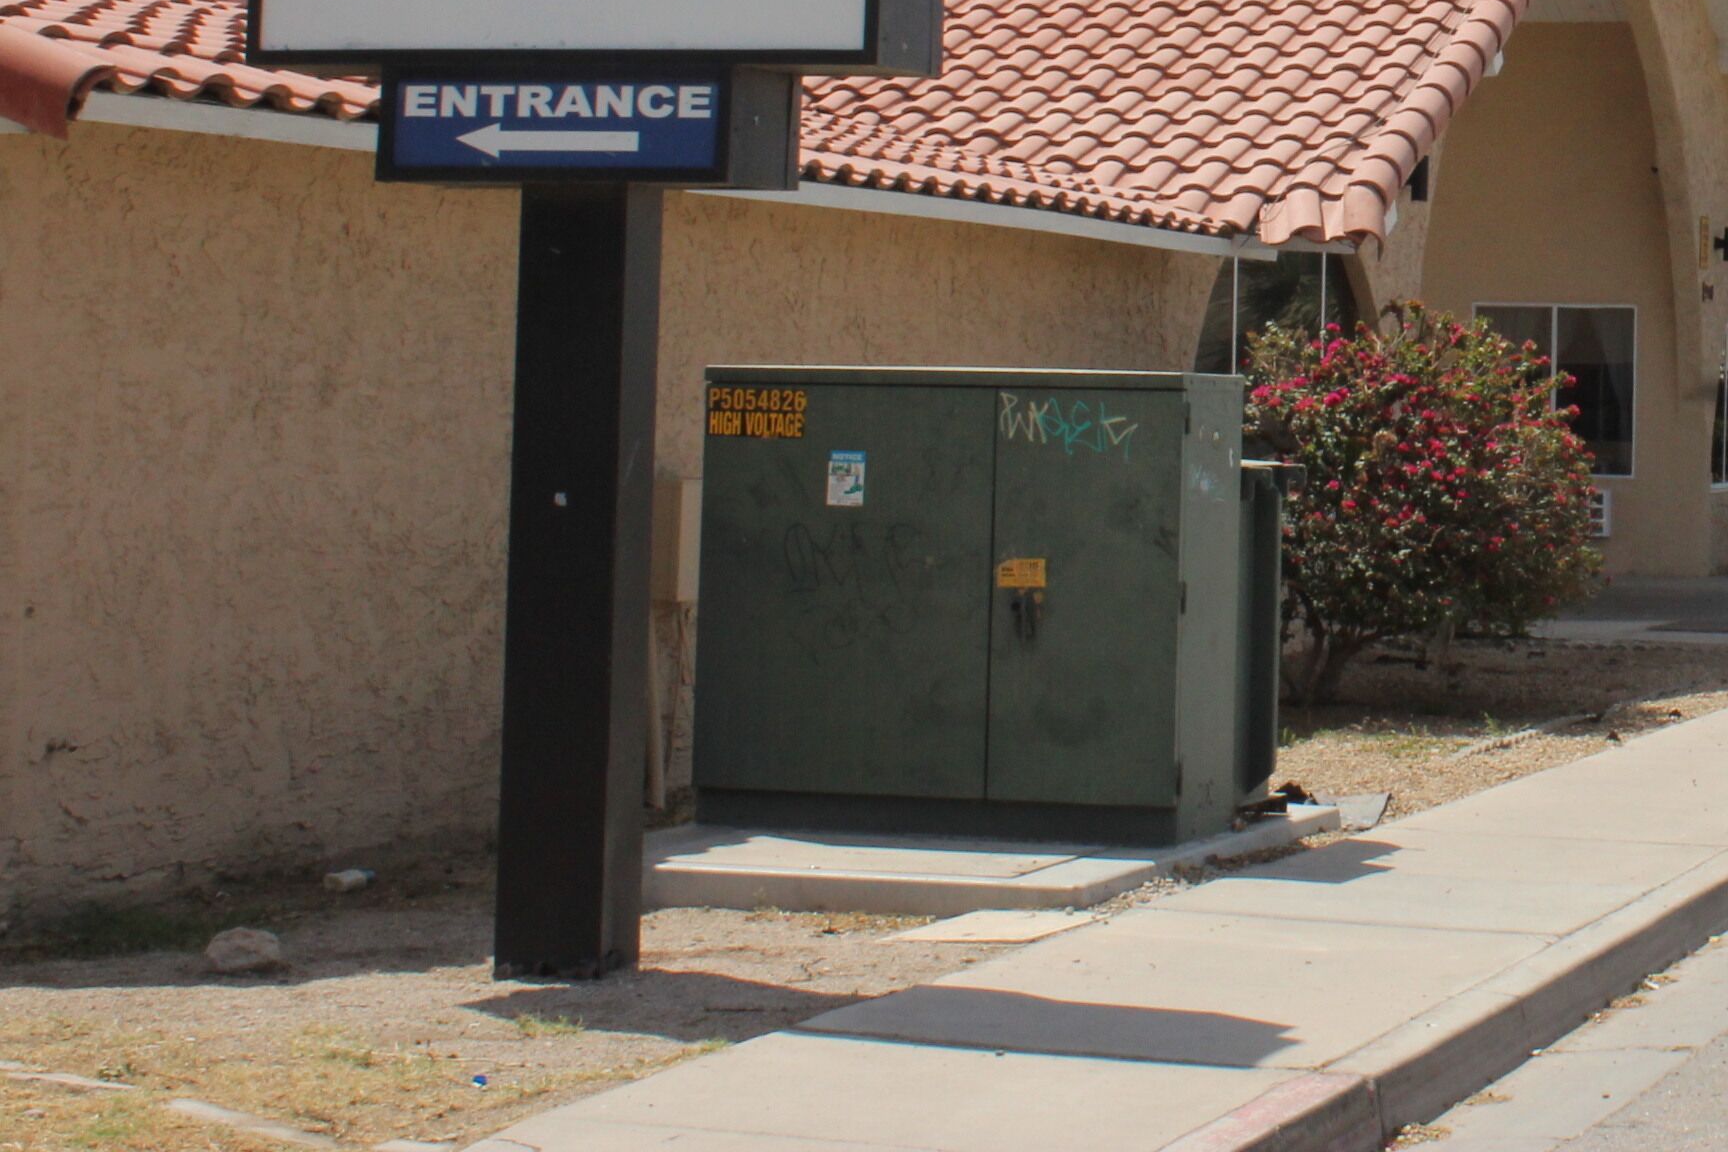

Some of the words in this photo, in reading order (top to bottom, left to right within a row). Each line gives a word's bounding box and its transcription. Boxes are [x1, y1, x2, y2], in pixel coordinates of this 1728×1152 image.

[404, 84, 712, 119] ENTRANCE
[709, 388, 807, 411] P5054826
[709, 411, 741, 435] HIGH
[745, 412, 803, 438] VOLTAGE
